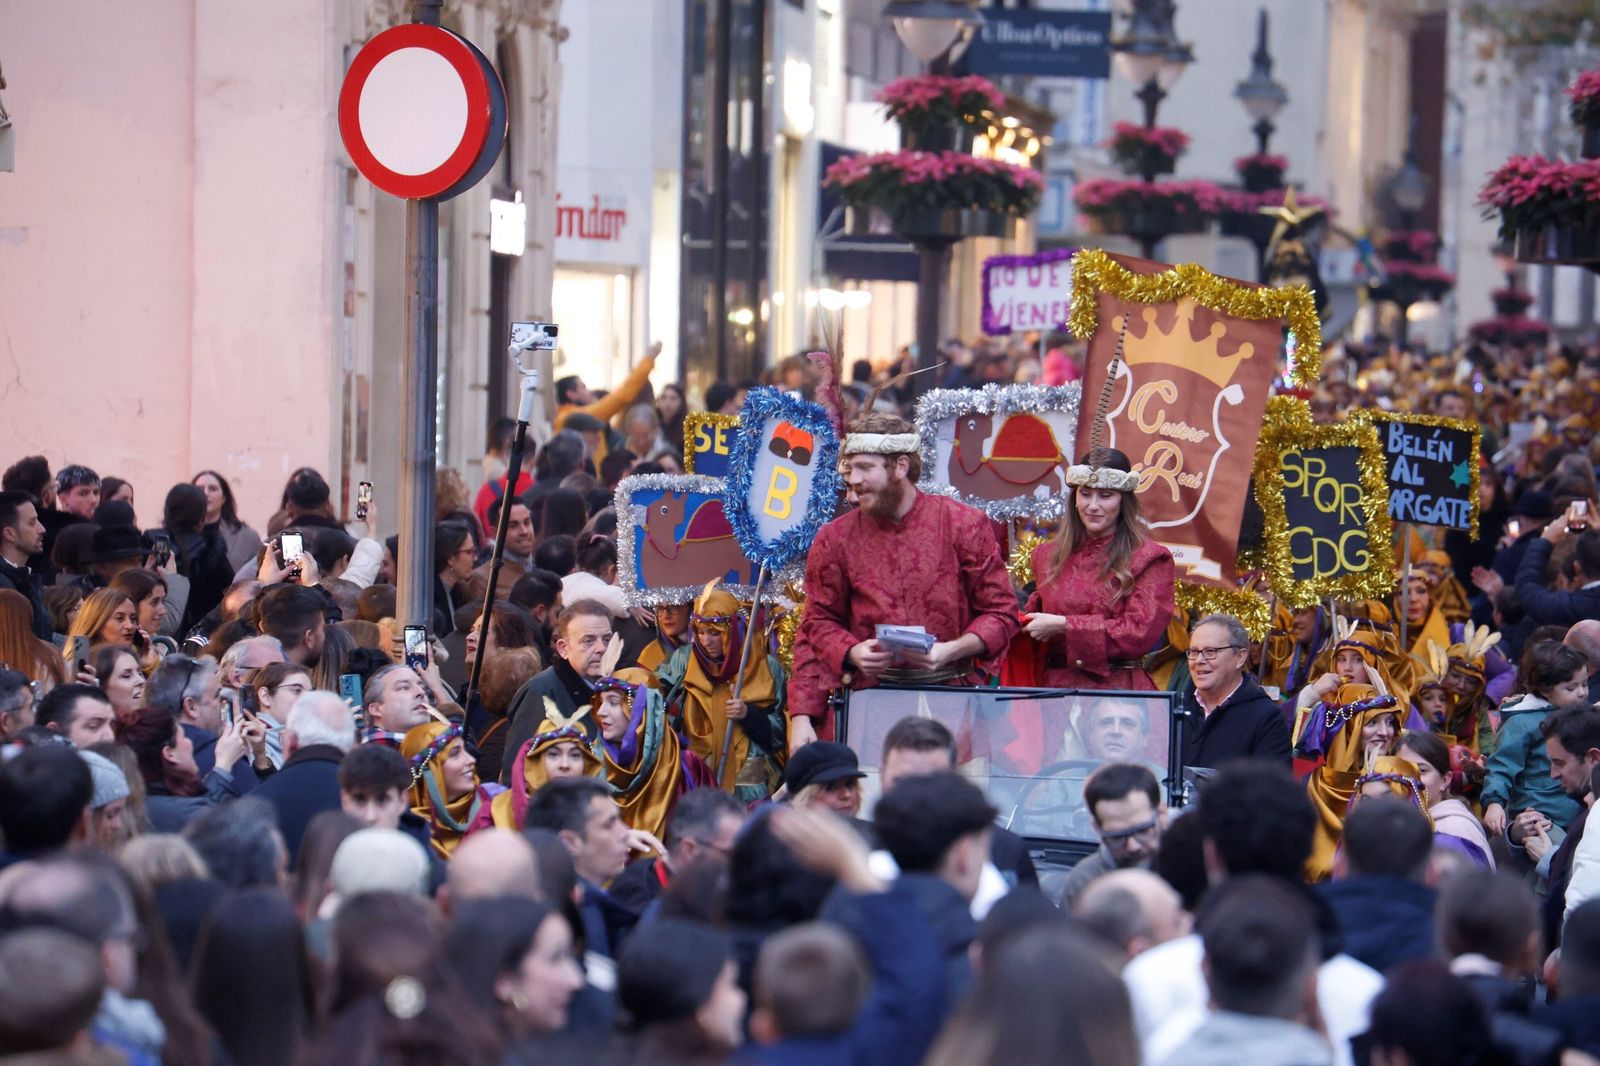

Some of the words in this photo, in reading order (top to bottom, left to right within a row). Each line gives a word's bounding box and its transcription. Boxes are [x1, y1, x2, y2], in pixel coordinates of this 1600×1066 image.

[1128, 380, 1210, 443] Cartero
[694, 423, 729, 455] SE
[1387, 422, 1453, 462] BELÉN
[763, 465, 798, 520] B
[1134, 441, 1203, 502] Real
[1279, 449, 1363, 526] SPQR
[1390, 455, 1424, 485] AL
[1387, 489, 1471, 529] ARGATE
[1289, 526, 1369, 579] CDG
